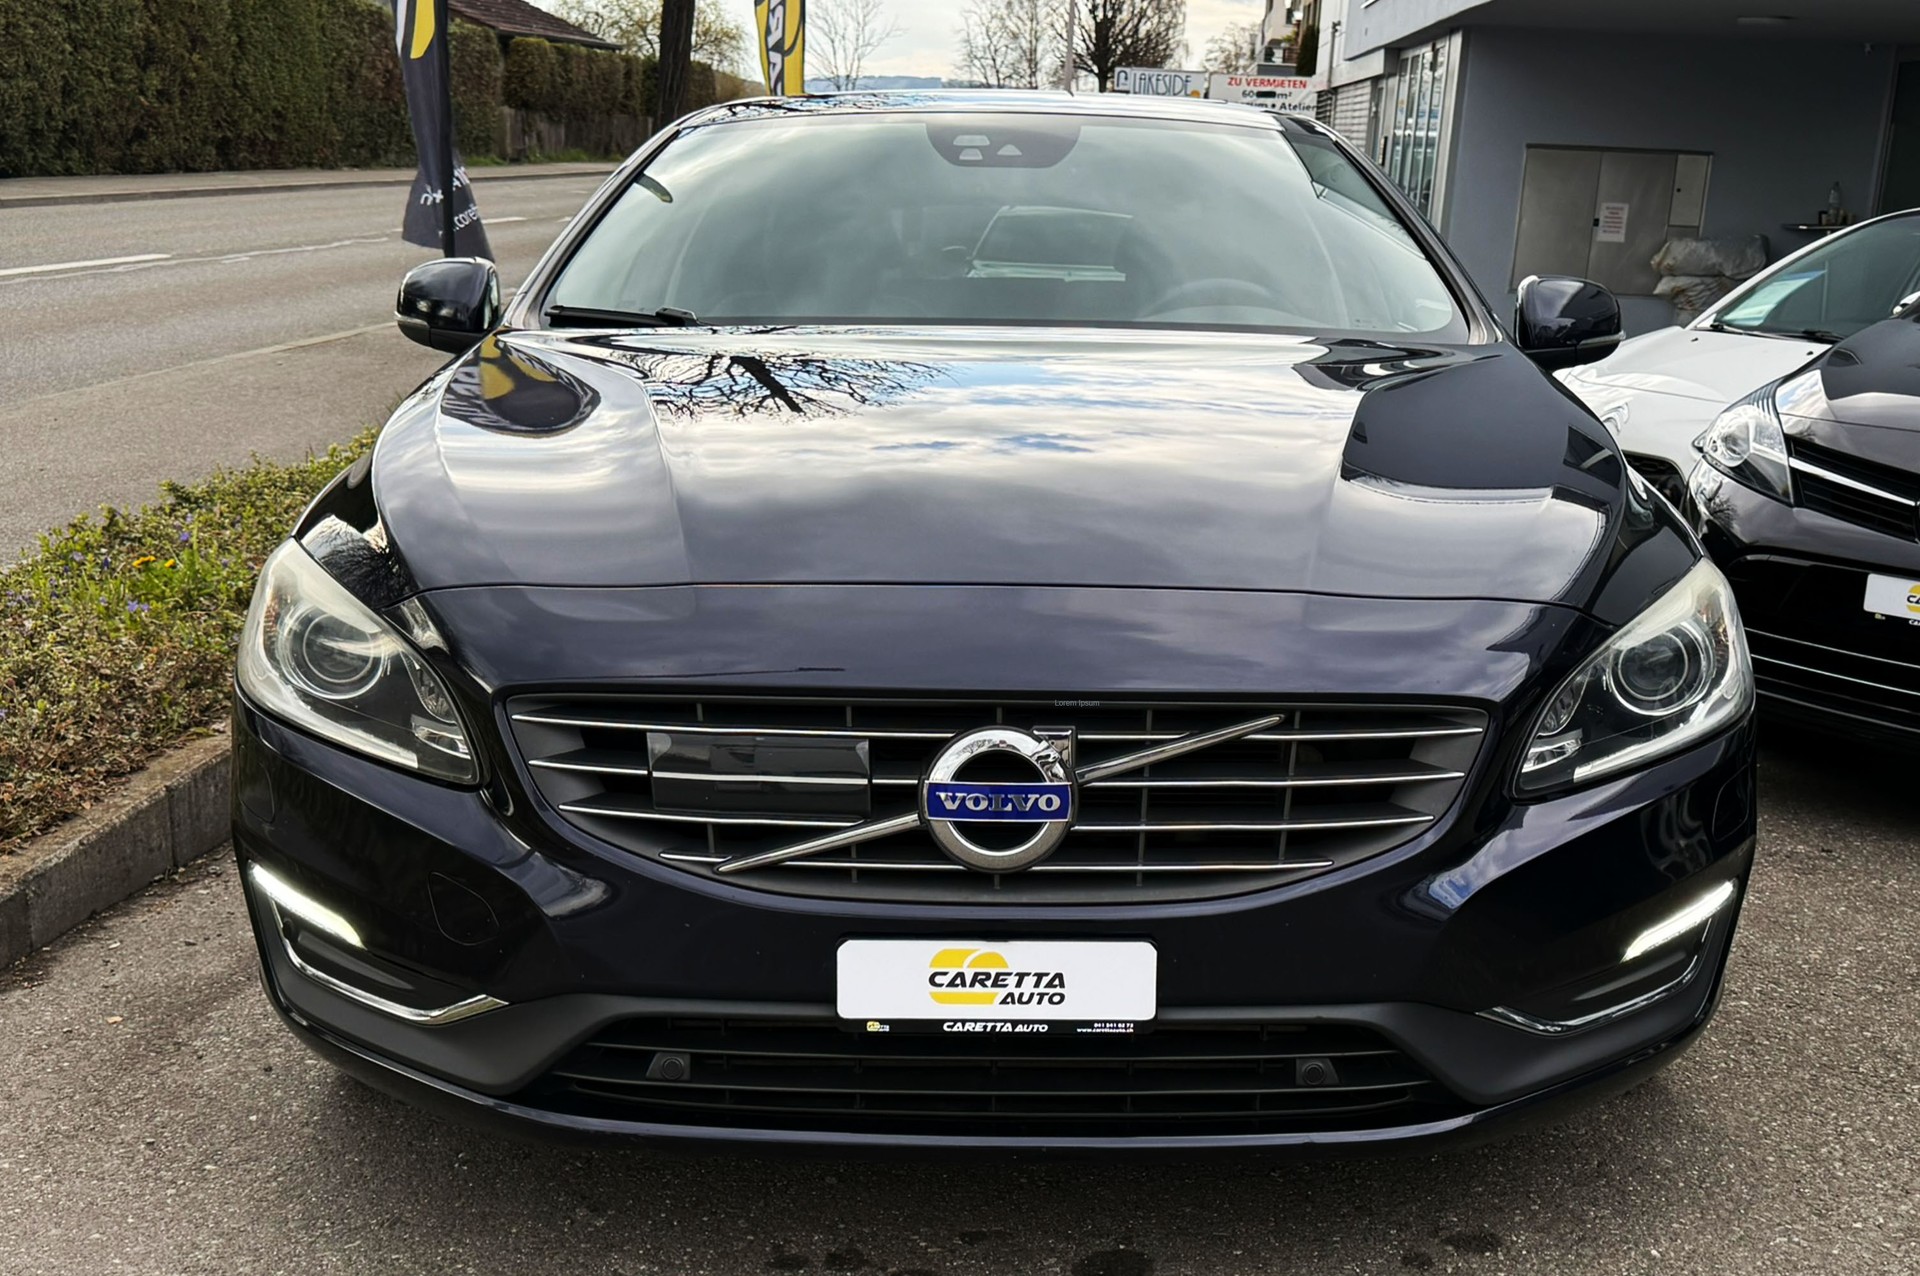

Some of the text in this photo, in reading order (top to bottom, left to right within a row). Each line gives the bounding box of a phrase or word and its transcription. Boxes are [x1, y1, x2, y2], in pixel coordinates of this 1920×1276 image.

[1133, 73, 1191, 96] LAKESIDE
[1227, 77, 1307, 88] ZU VERMIETEN
[936, 792, 1061, 811] VOLVO
[928, 971, 1065, 988] CARETTA
[999, 992, 1065, 1005] AUTO
[943, 1022, 1049, 1032] CARETTA AUTO
